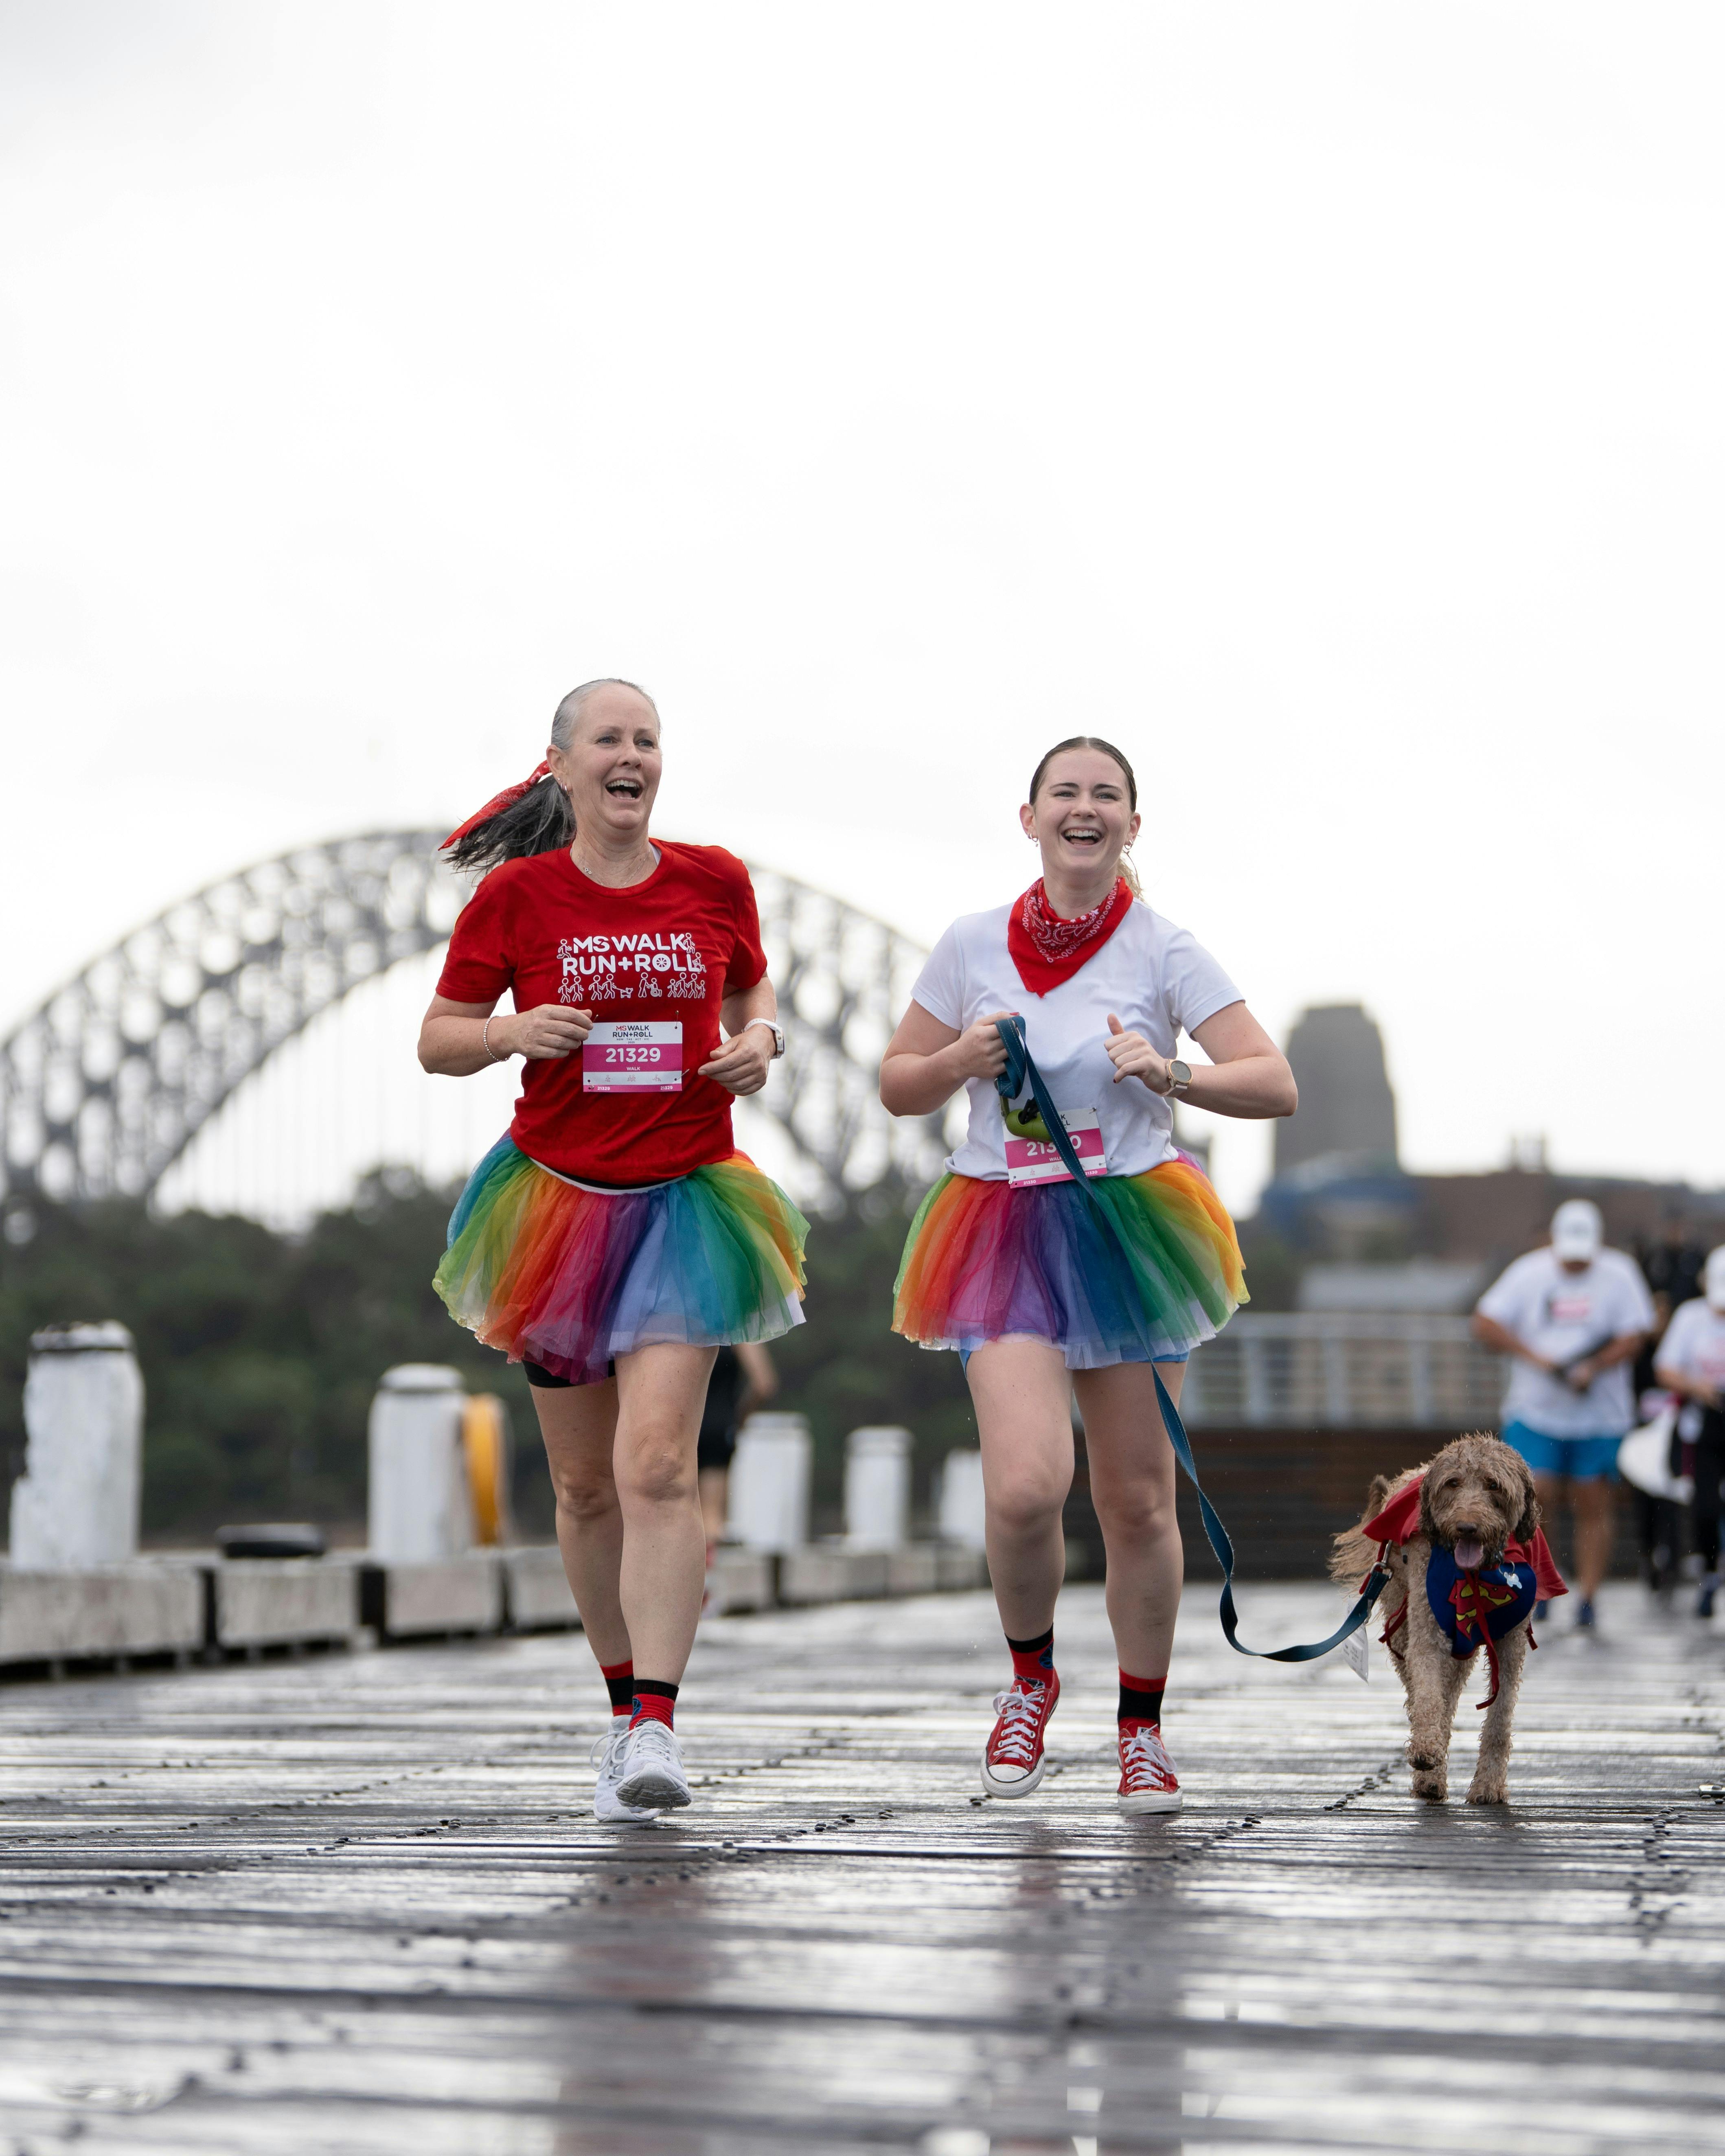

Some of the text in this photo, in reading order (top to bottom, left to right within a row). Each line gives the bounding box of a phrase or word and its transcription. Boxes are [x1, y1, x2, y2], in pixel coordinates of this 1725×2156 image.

[611, 933, 687, 952] WALK
[606, 1047, 661, 1063] 21329
[1026, 1135, 1081, 1156] 2130
